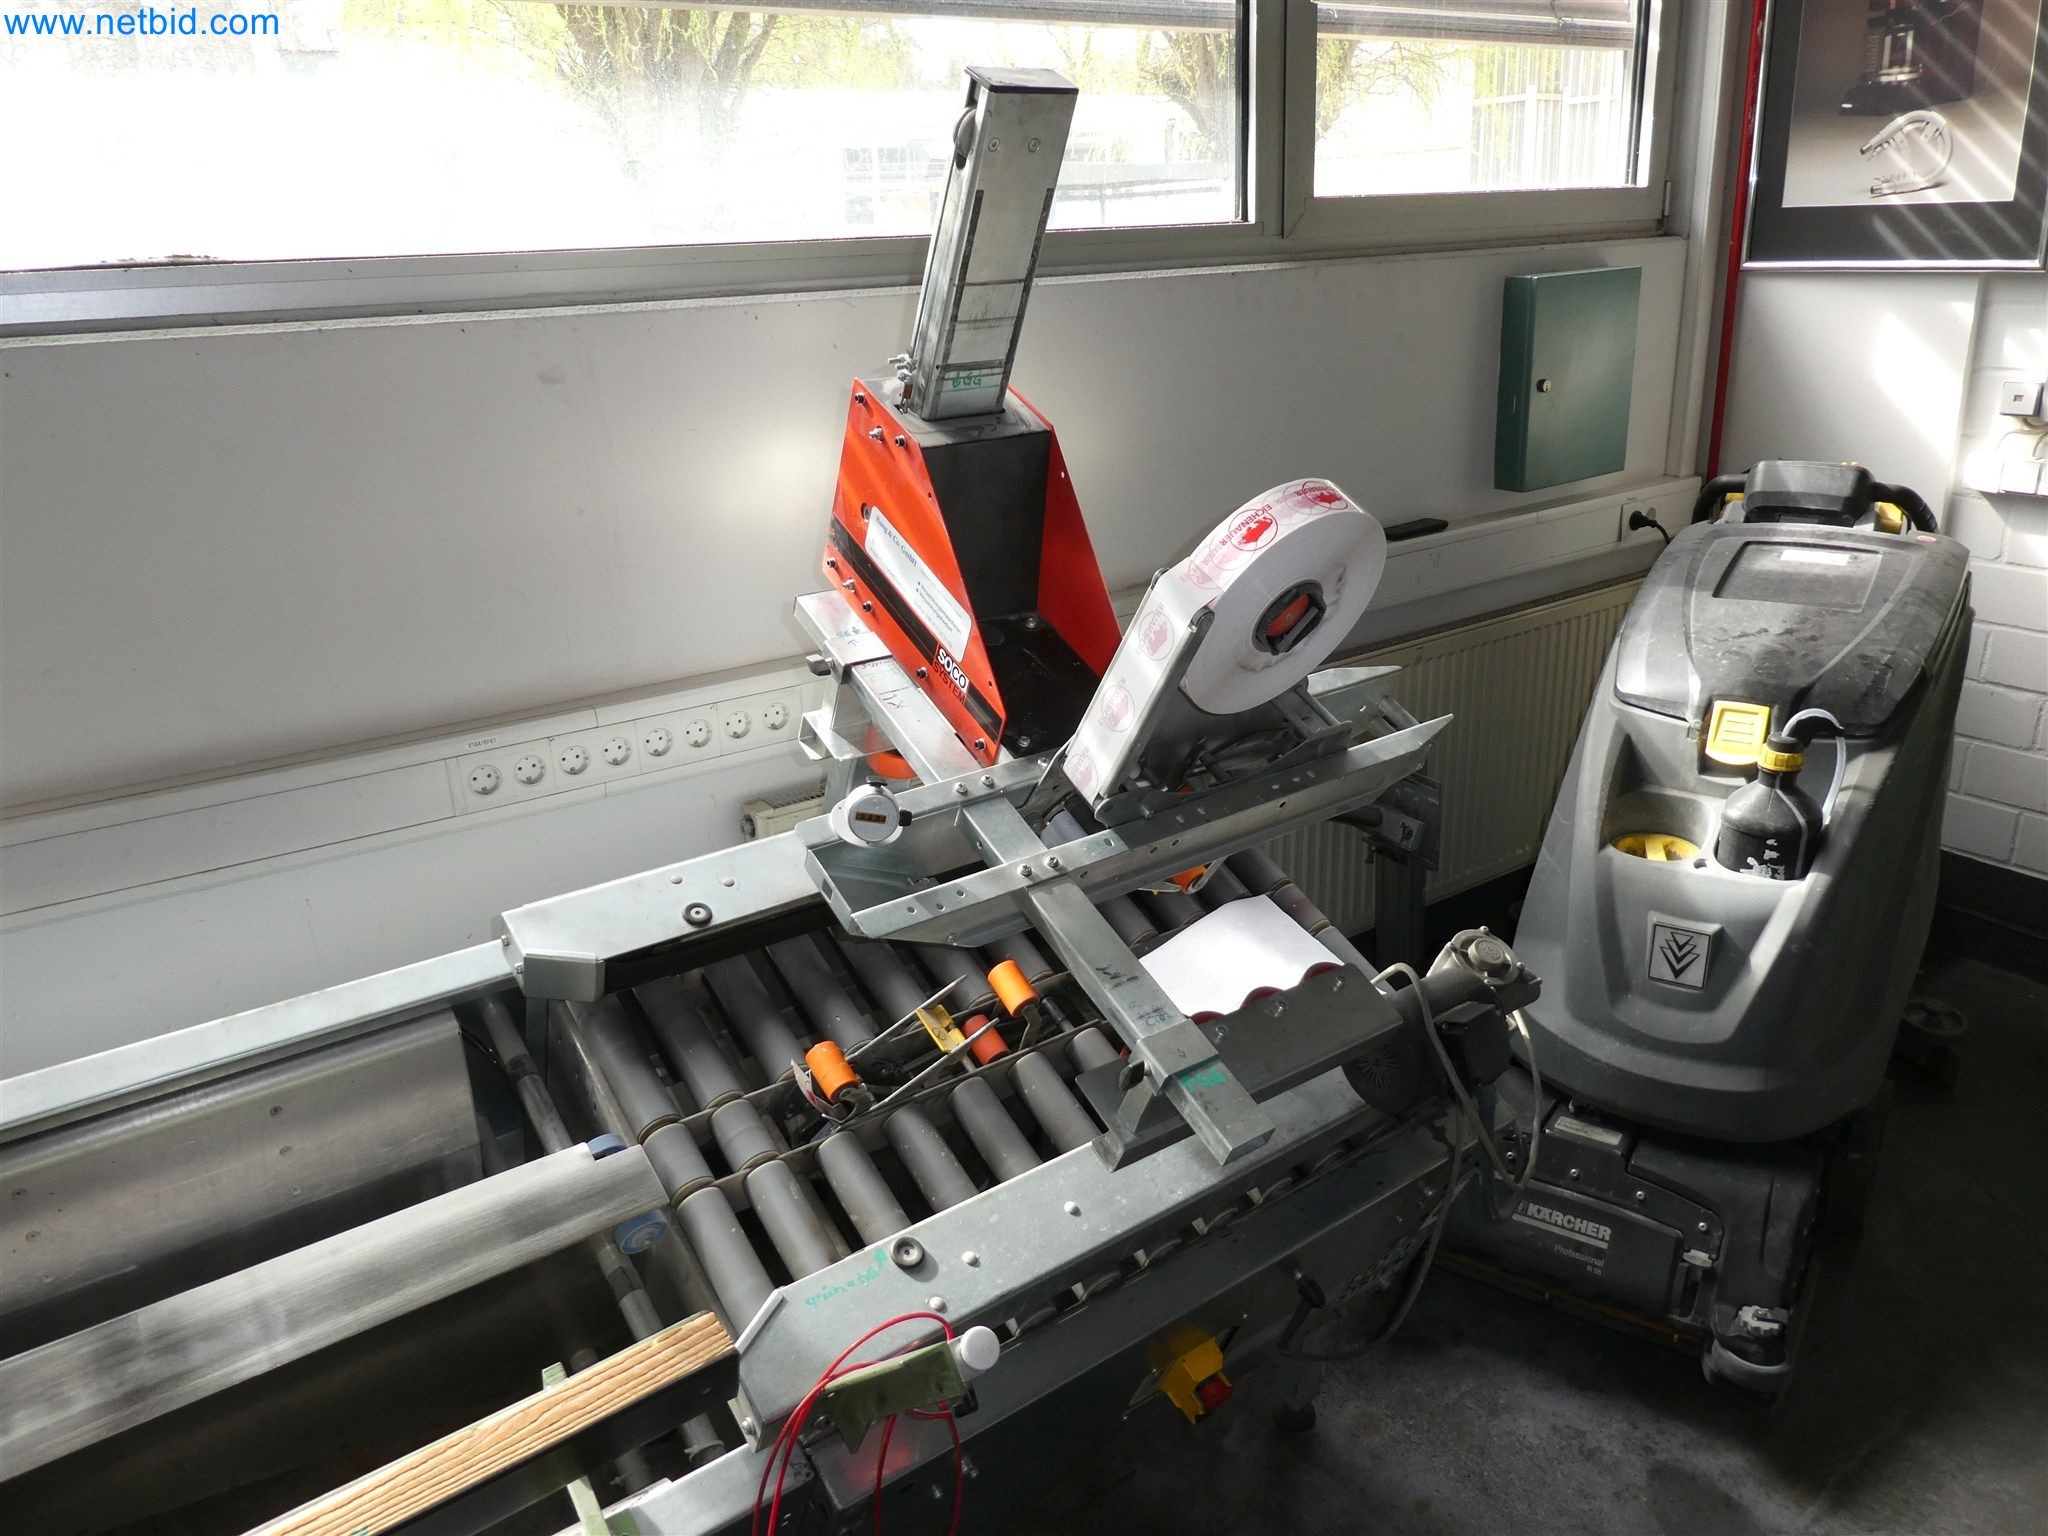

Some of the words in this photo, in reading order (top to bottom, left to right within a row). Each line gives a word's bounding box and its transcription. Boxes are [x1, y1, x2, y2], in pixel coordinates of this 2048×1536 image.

[1221, 503, 1273, 546] EICHENAUER
[901, 543, 917, 567] GmbH
[933, 661, 966, 706] SYSTEM
[938, 648, 967, 689] SOCO
[1527, 1203, 1611, 1241] KÄRCHER
[1554, 1244, 1605, 1268] Professional
